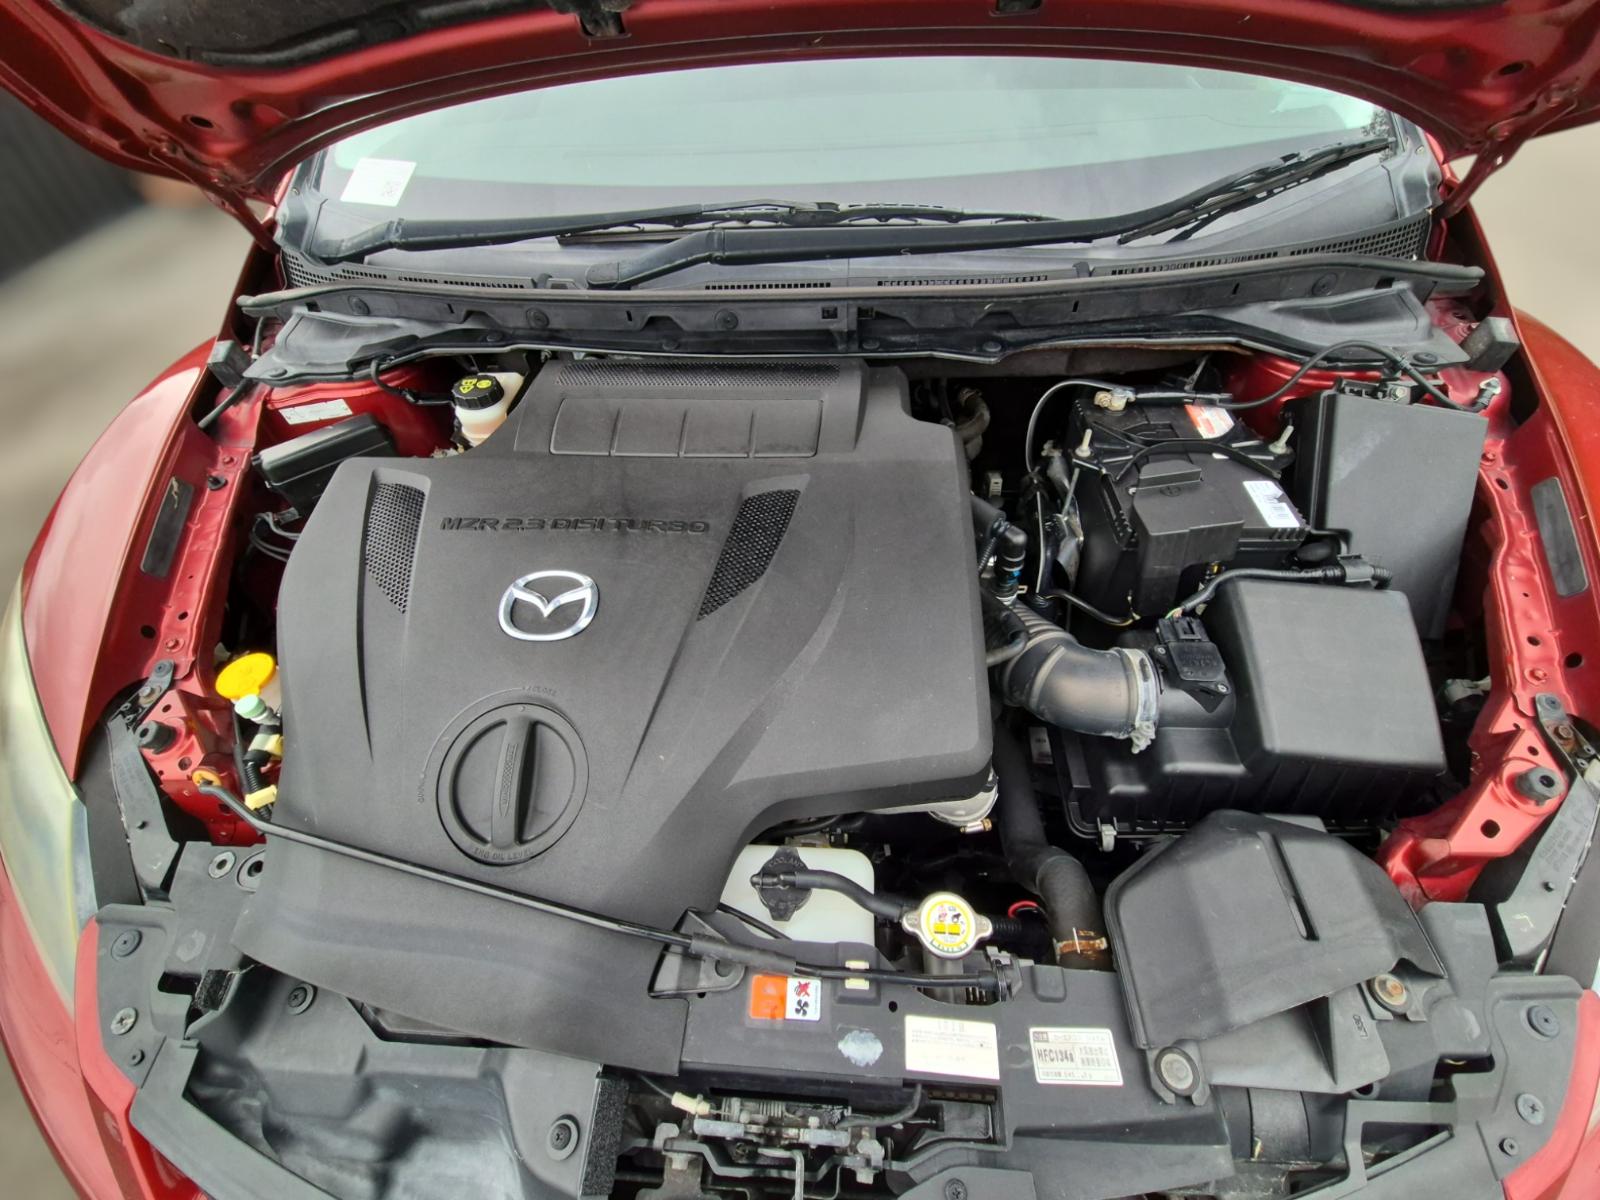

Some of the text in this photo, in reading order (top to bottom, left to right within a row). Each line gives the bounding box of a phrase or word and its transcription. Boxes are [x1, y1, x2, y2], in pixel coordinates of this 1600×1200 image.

[440, 517, 710, 534] MZR 2.3 DISI TURBO
[1037, 1048, 1074, 1063] HFC134a
